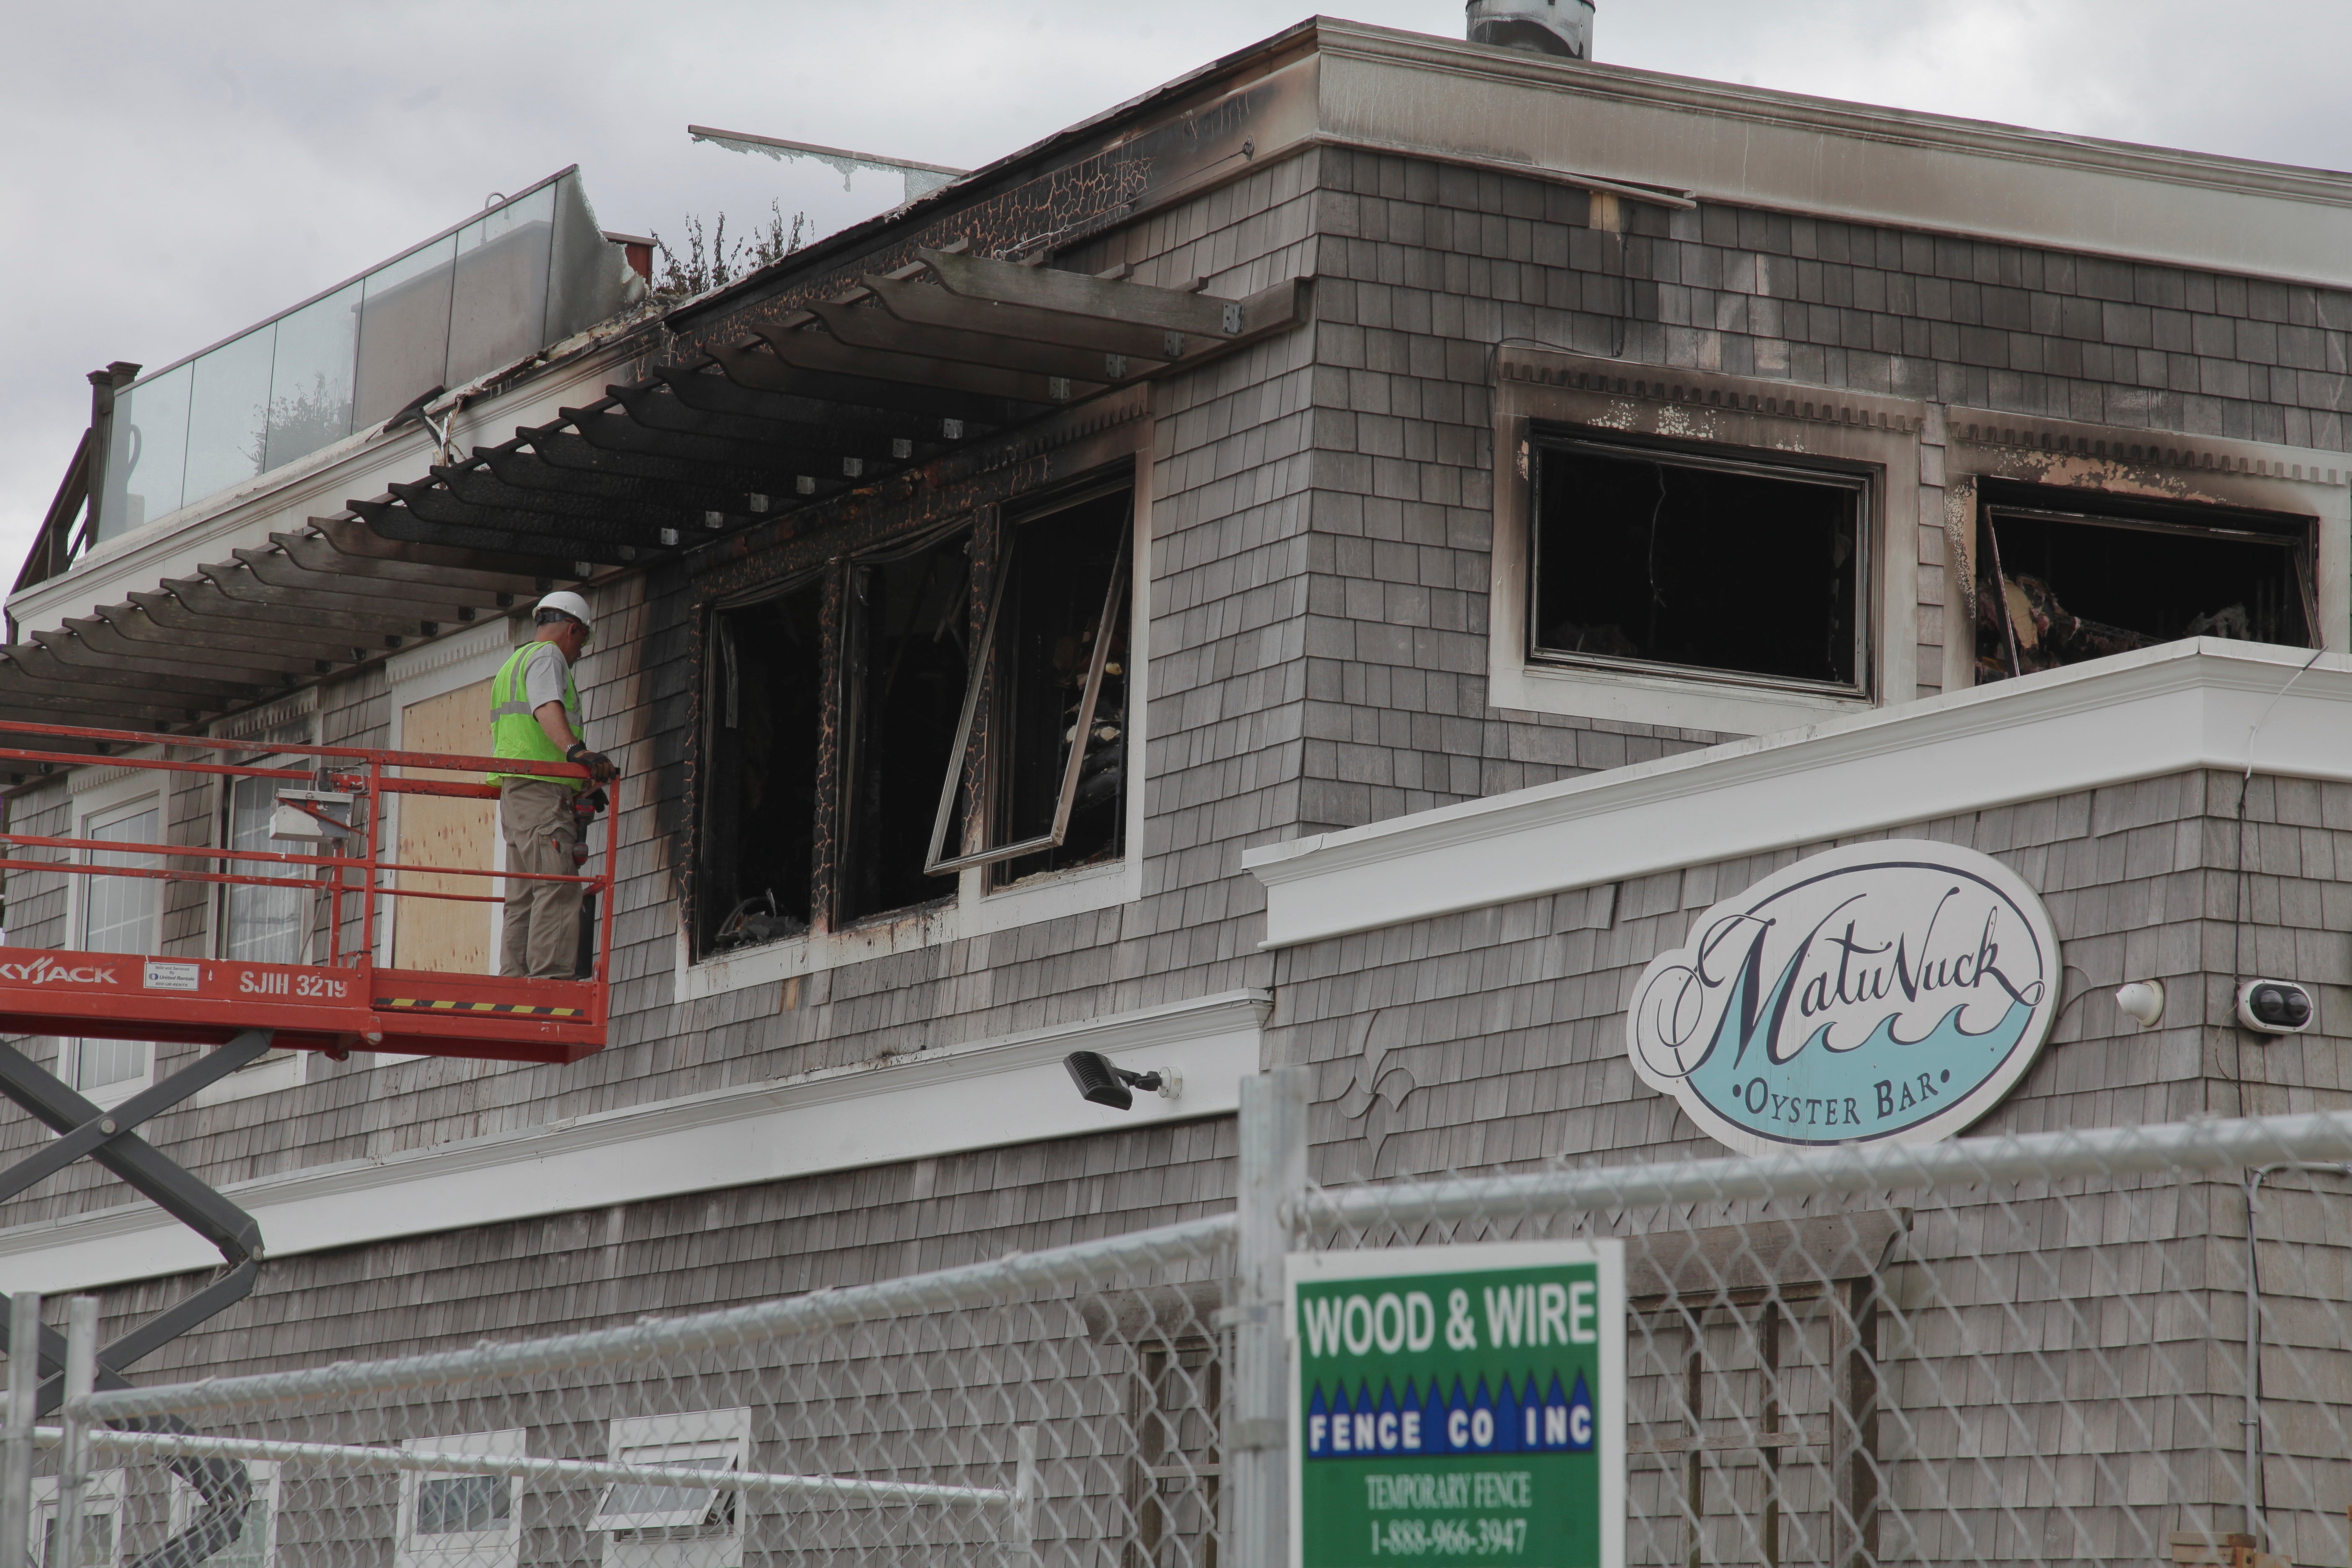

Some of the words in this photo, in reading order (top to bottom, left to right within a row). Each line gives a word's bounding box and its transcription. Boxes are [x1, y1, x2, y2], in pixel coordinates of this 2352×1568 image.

[296, 975, 348, 998] 3219
[1745, 1077, 1861, 1125] OYSTER
[1873, 1072, 1939, 1119] BAR
[1303, 1292, 1435, 1358] WOOD
[1445, 1288, 1477, 1351] &
[1483, 1281, 1596, 1349] WIRE
[1309, 1411, 1421, 1451] FENCE
[1447, 1408, 1494, 1447] CO
[1525, 1405, 1591, 1445] INC
[1364, 1473, 1472, 1510] TEMPORARY
[1473, 1471, 1532, 1508] FENCE
[1371, 1518, 1527, 1555] 1-888-966-3947
